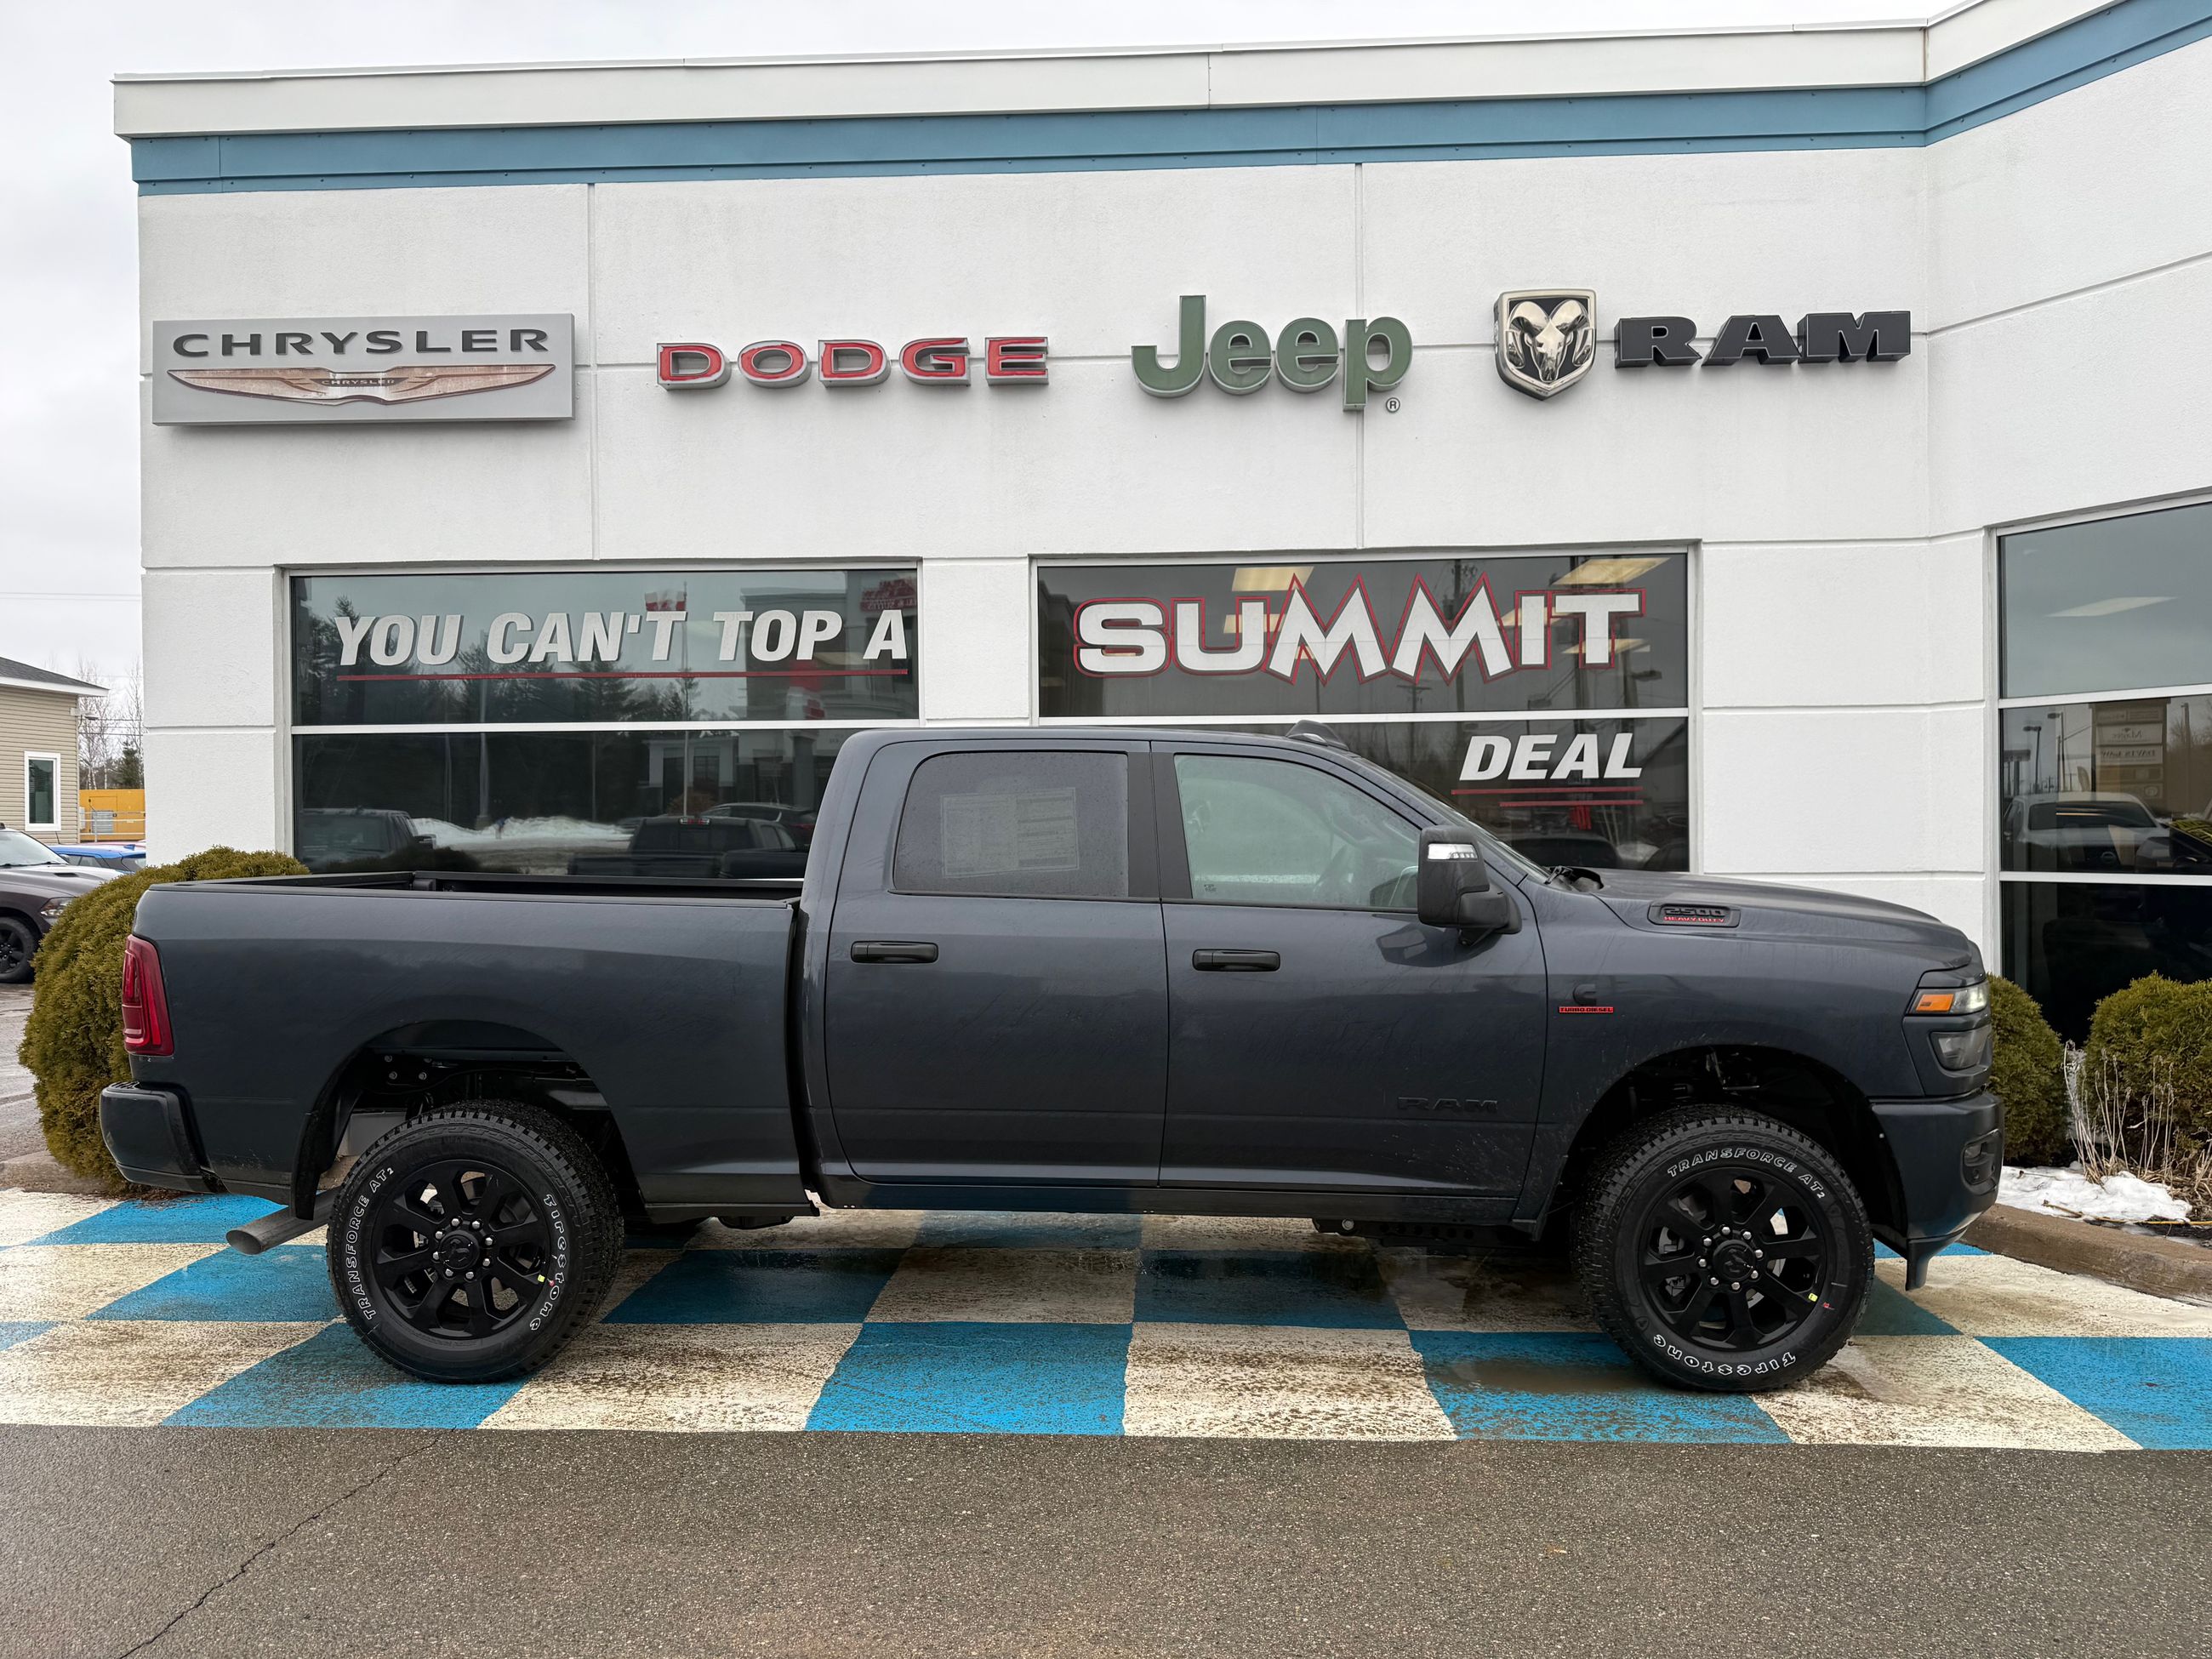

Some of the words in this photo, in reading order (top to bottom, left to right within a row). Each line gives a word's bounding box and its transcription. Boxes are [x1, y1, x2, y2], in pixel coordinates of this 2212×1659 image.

[172, 328, 550, 357] CHRYSLER
[657, 336, 1049, 389] DODGE
[1131, 294, 1413, 412] Jeep
[1614, 310, 1911, 368] RAM
[334, 613, 465, 666] YOU
[486, 610, 687, 663] CAN'T
[713, 609, 844, 662] TOP
[863, 608, 909, 660] A
[1072, 571, 1647, 686] SUMMIT
[1458, 733, 1644, 780] DEAL
[1662, 907, 1726, 917] 2500
[1396, 1096, 1499, 1114] RAM
[1667, 1147, 1798, 1178] TRANSFORCE
[345, 1194, 376, 1320] TRANSFORCE
